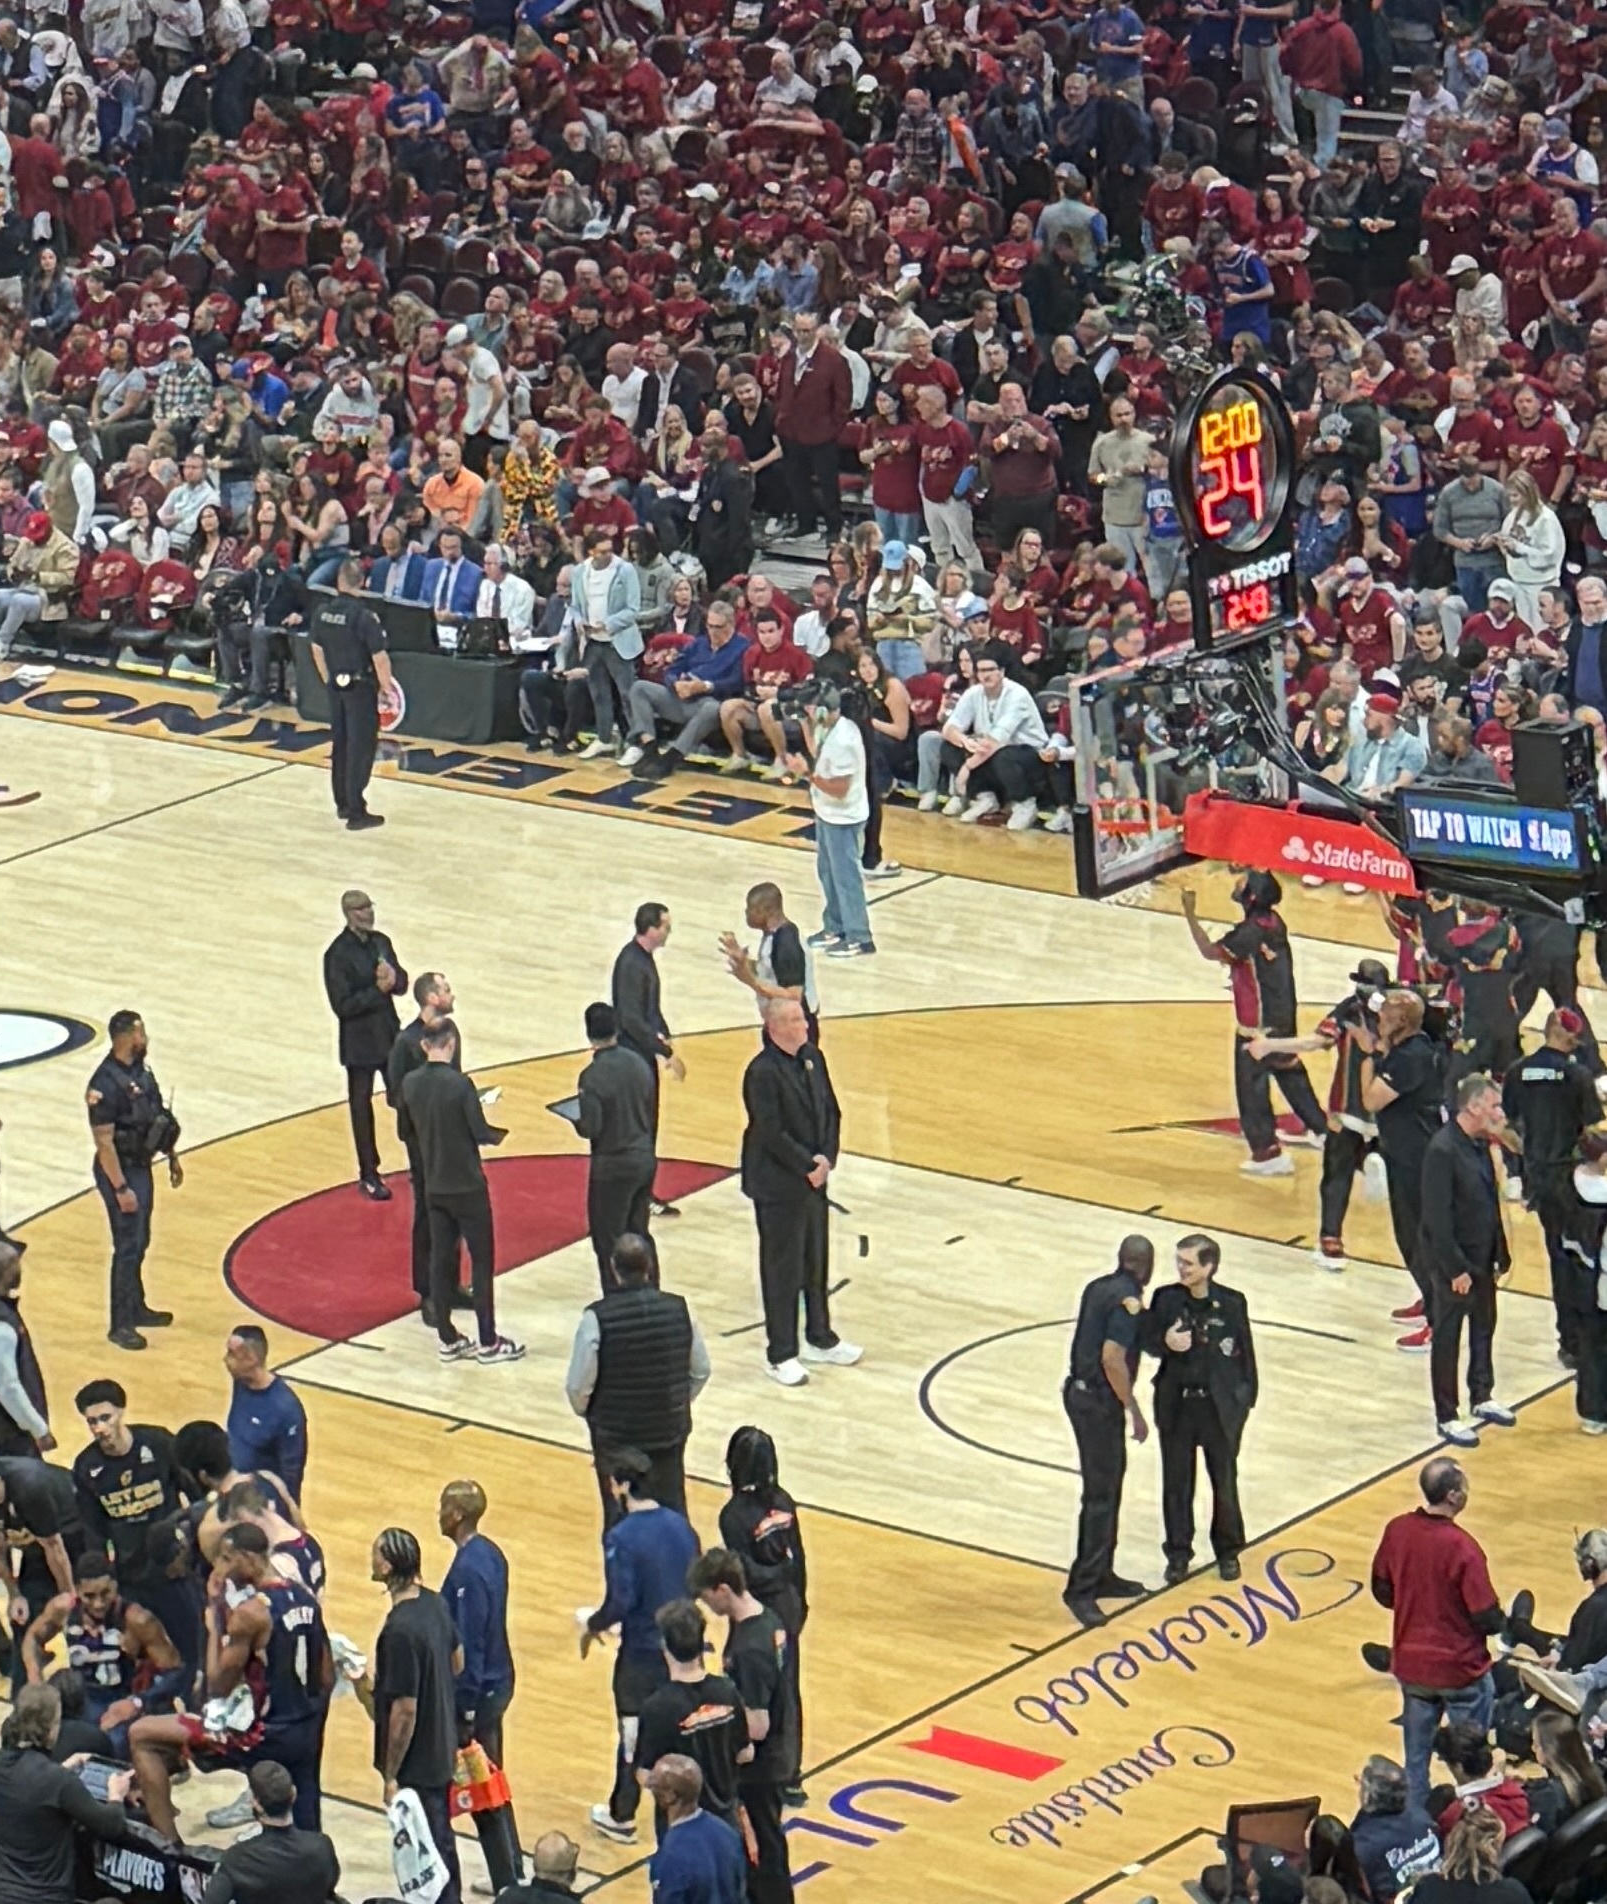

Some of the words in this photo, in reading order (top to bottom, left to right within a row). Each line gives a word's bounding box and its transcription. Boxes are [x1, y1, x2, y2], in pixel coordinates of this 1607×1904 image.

[1200, 401, 1263, 457] 12:00
[1200, 446, 1264, 536] 24
[1229, 552, 1293, 589] TISSOT
[1410, 808, 1441, 841] TAP
[1444, 812, 1465, 842] TO
[1465, 814, 1522, 849] WATCH
[1014, 1547, 1364, 1737] Michelob
[989, 1724, 1236, 1849] Courtside
